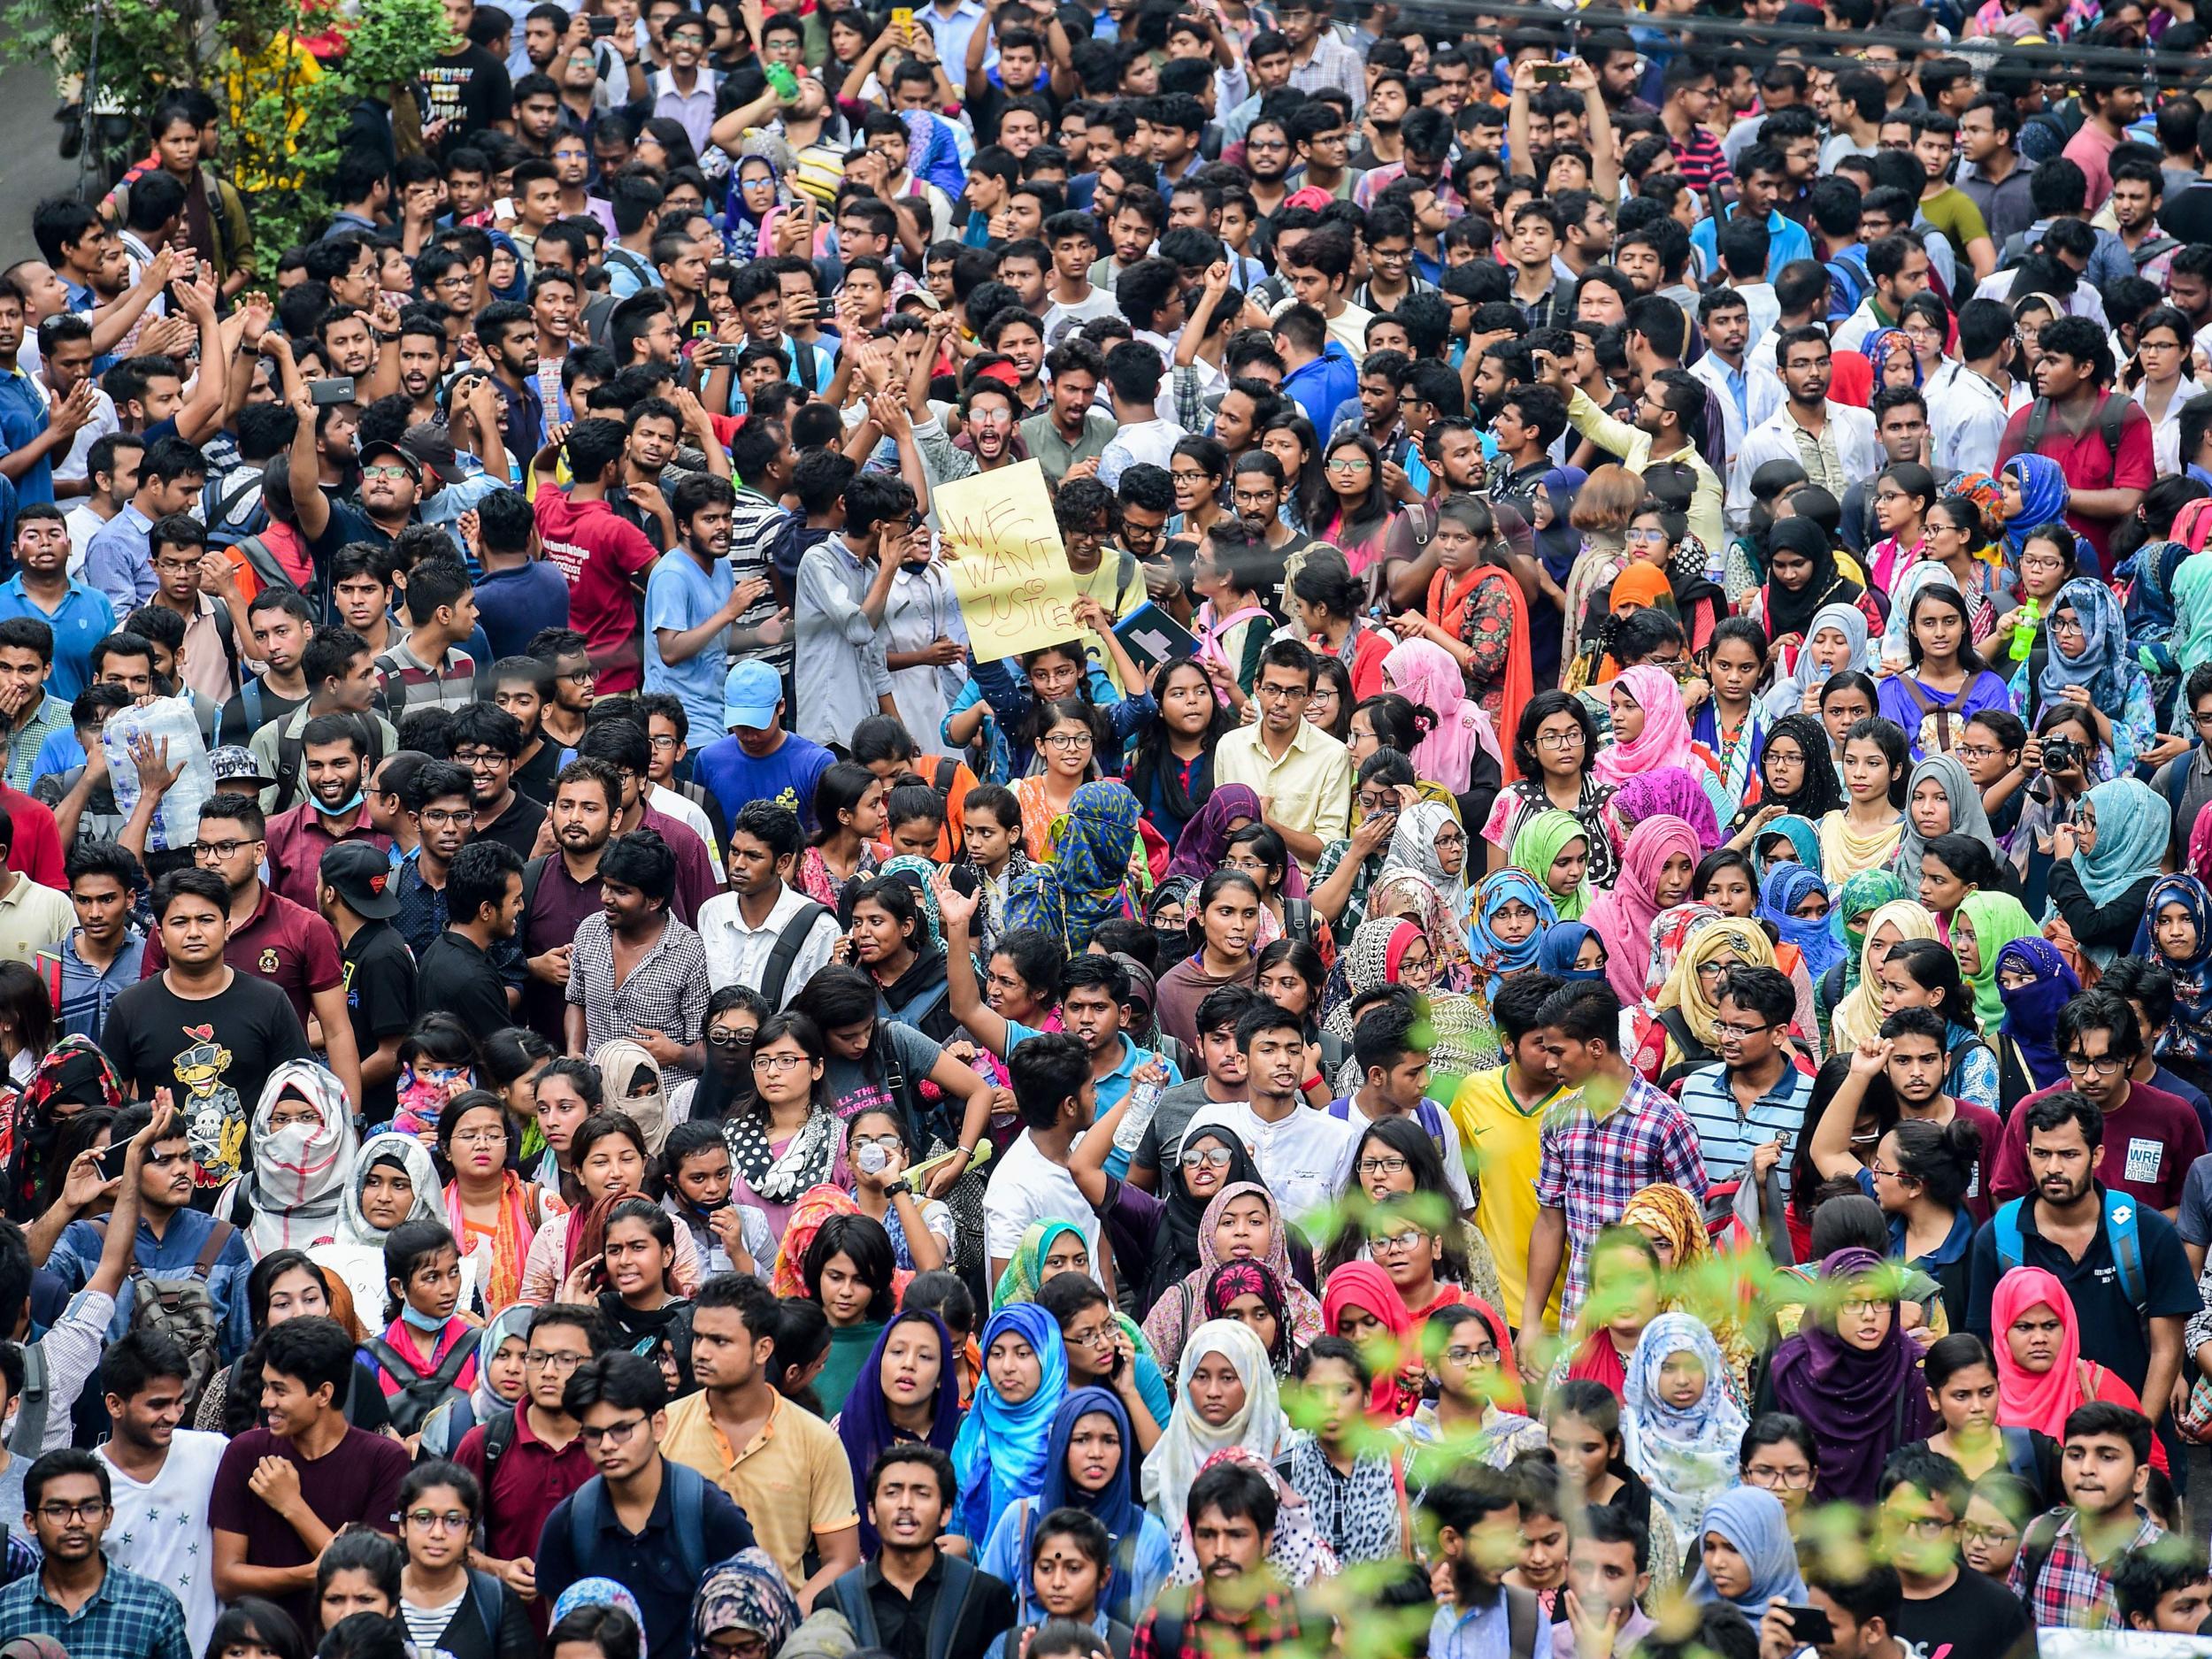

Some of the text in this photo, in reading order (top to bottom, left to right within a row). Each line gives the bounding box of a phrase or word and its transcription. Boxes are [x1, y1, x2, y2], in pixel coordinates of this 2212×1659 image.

[946, 496, 1033, 549] WE
[962, 536, 1052, 588] WANT
[836, 1085, 879, 1108] LL THE
[2130, 1148, 2161, 1164] WRE
[2126, 1169, 2146, 1180] 2018
[2128, 1160, 2157, 1173] FESTIVAL
